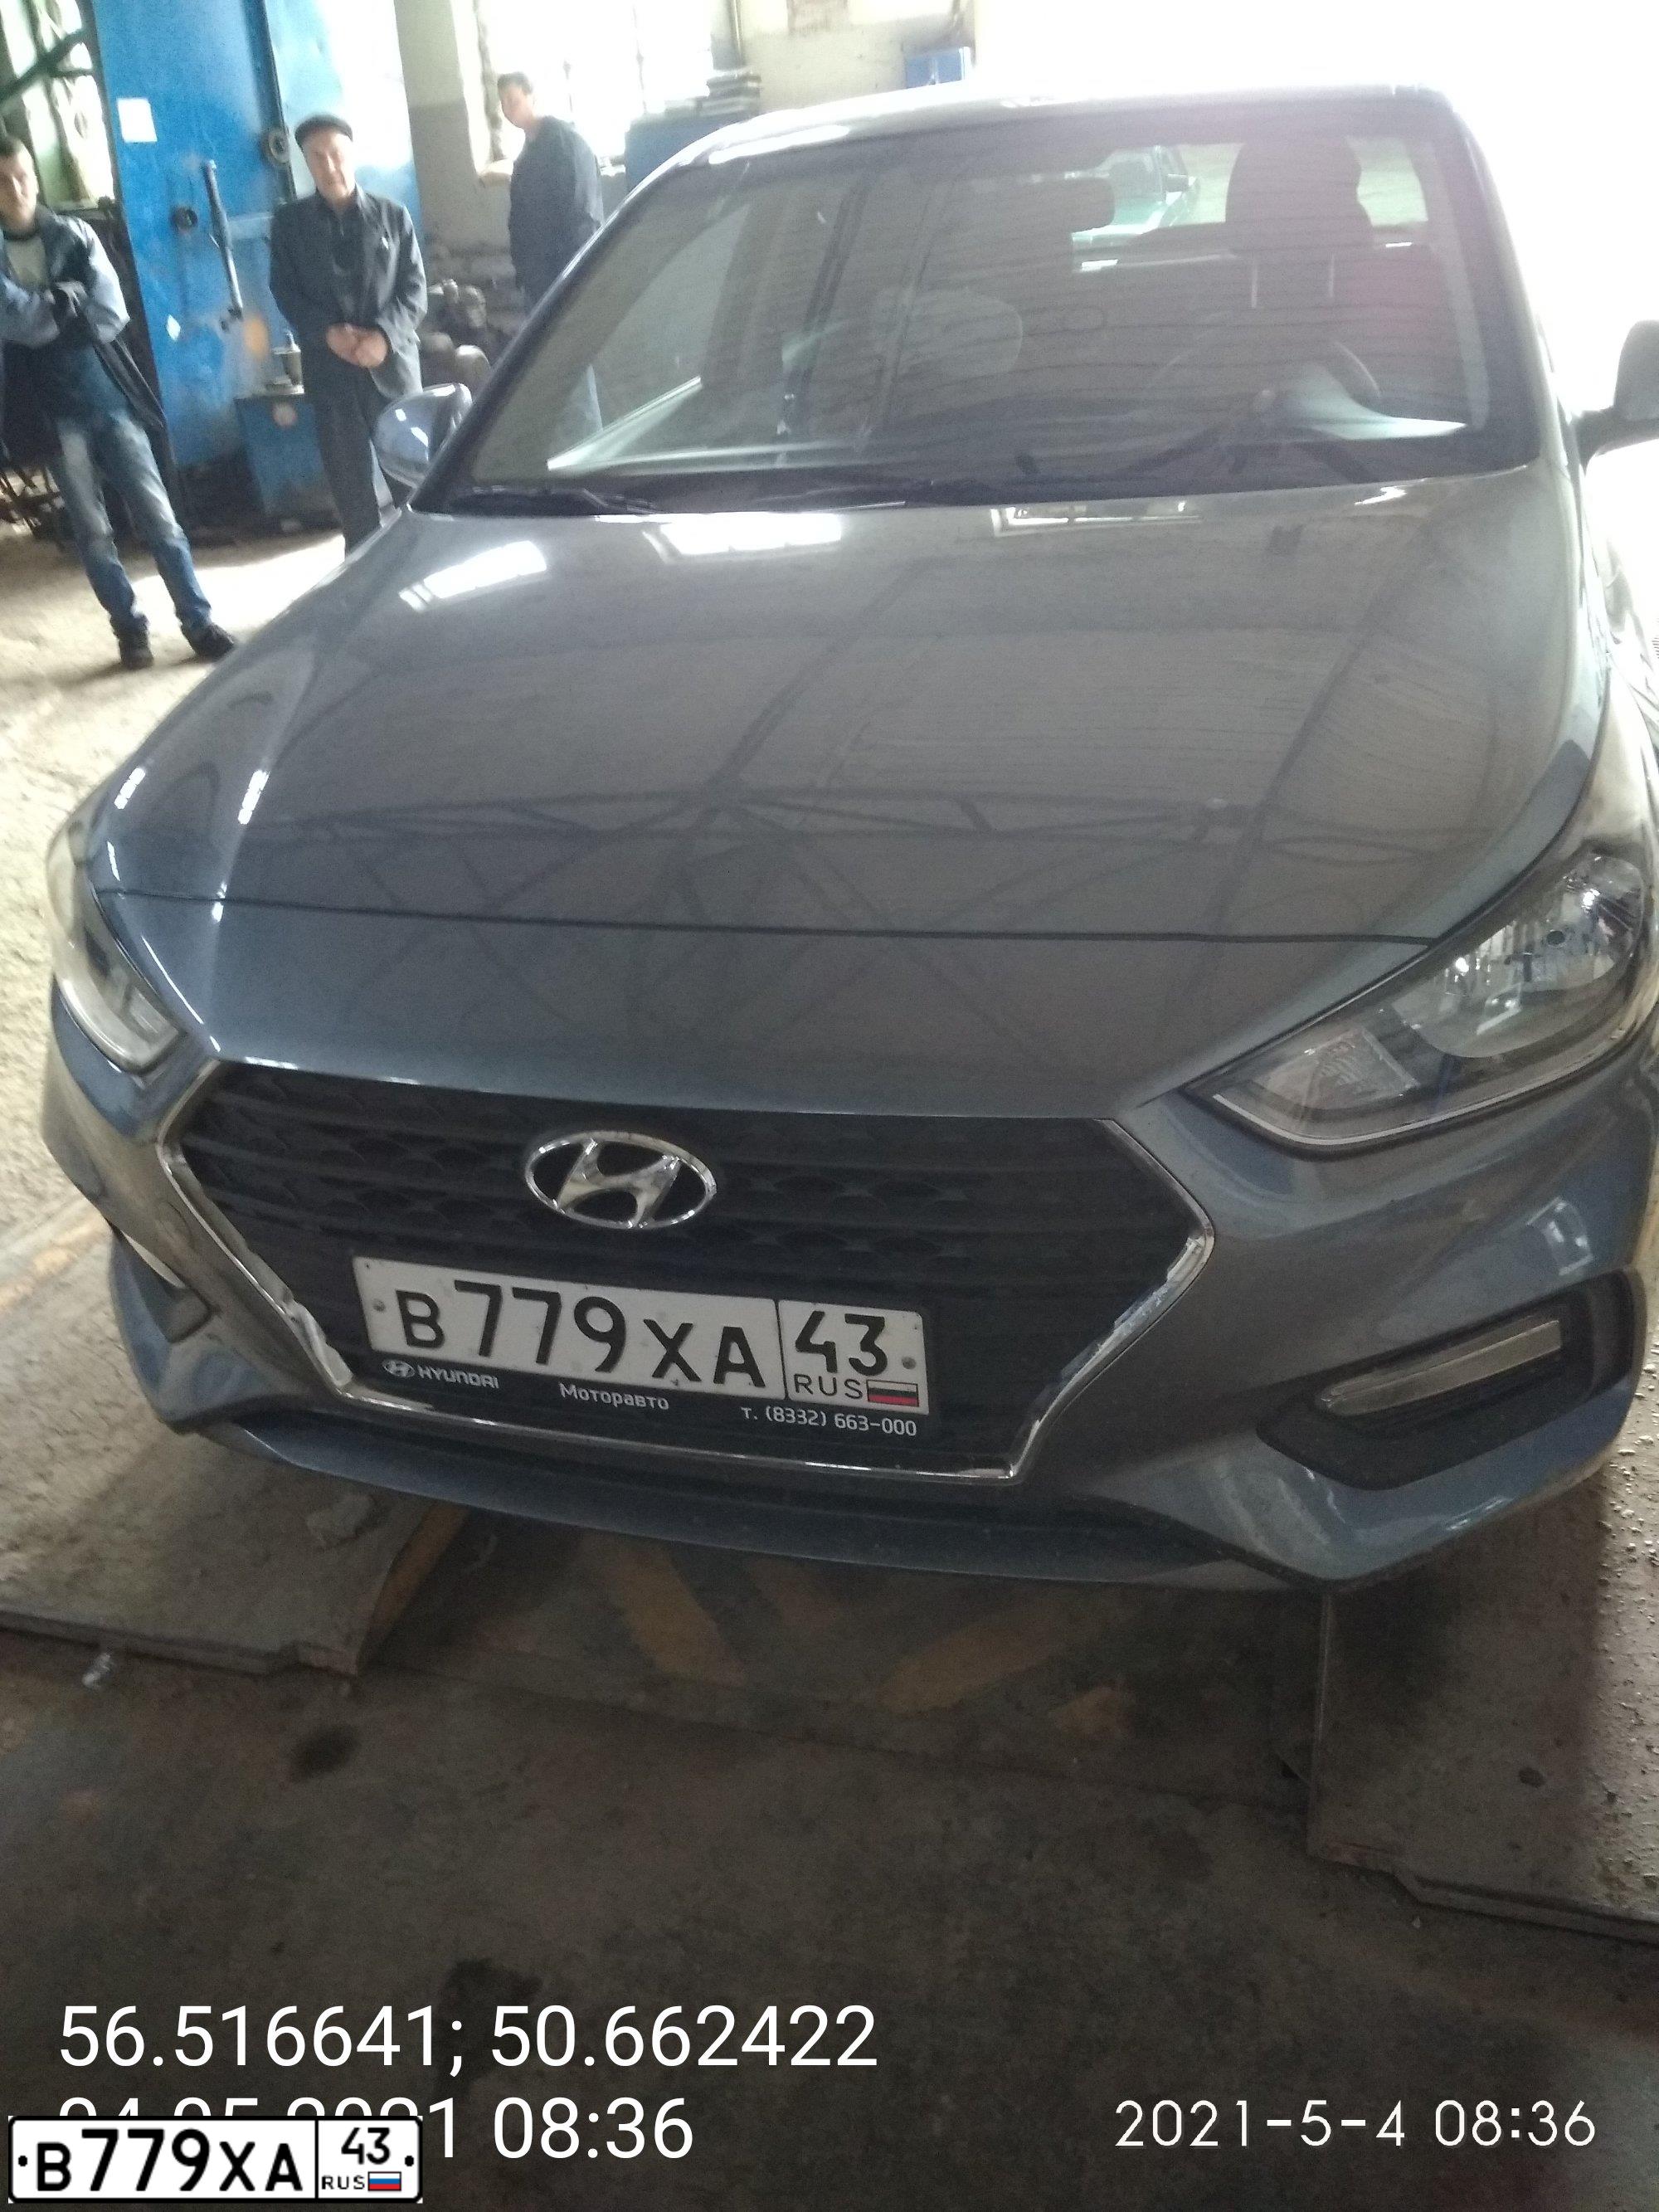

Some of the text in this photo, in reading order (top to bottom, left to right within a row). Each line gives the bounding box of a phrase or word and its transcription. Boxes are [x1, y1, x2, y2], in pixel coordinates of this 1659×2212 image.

[396, 1279, 767, 1388] В779ХА
[795, 1310, 888, 1376] 43
[417, 1365, 499, 1389] HYUNDAI
[794, 1373, 864, 1400] RUS
[559, 1382, 669, 1410] Моторавто
[766, 1406, 827, 1427] (8332)
[834, 1413, 917, 1436] 663-000
